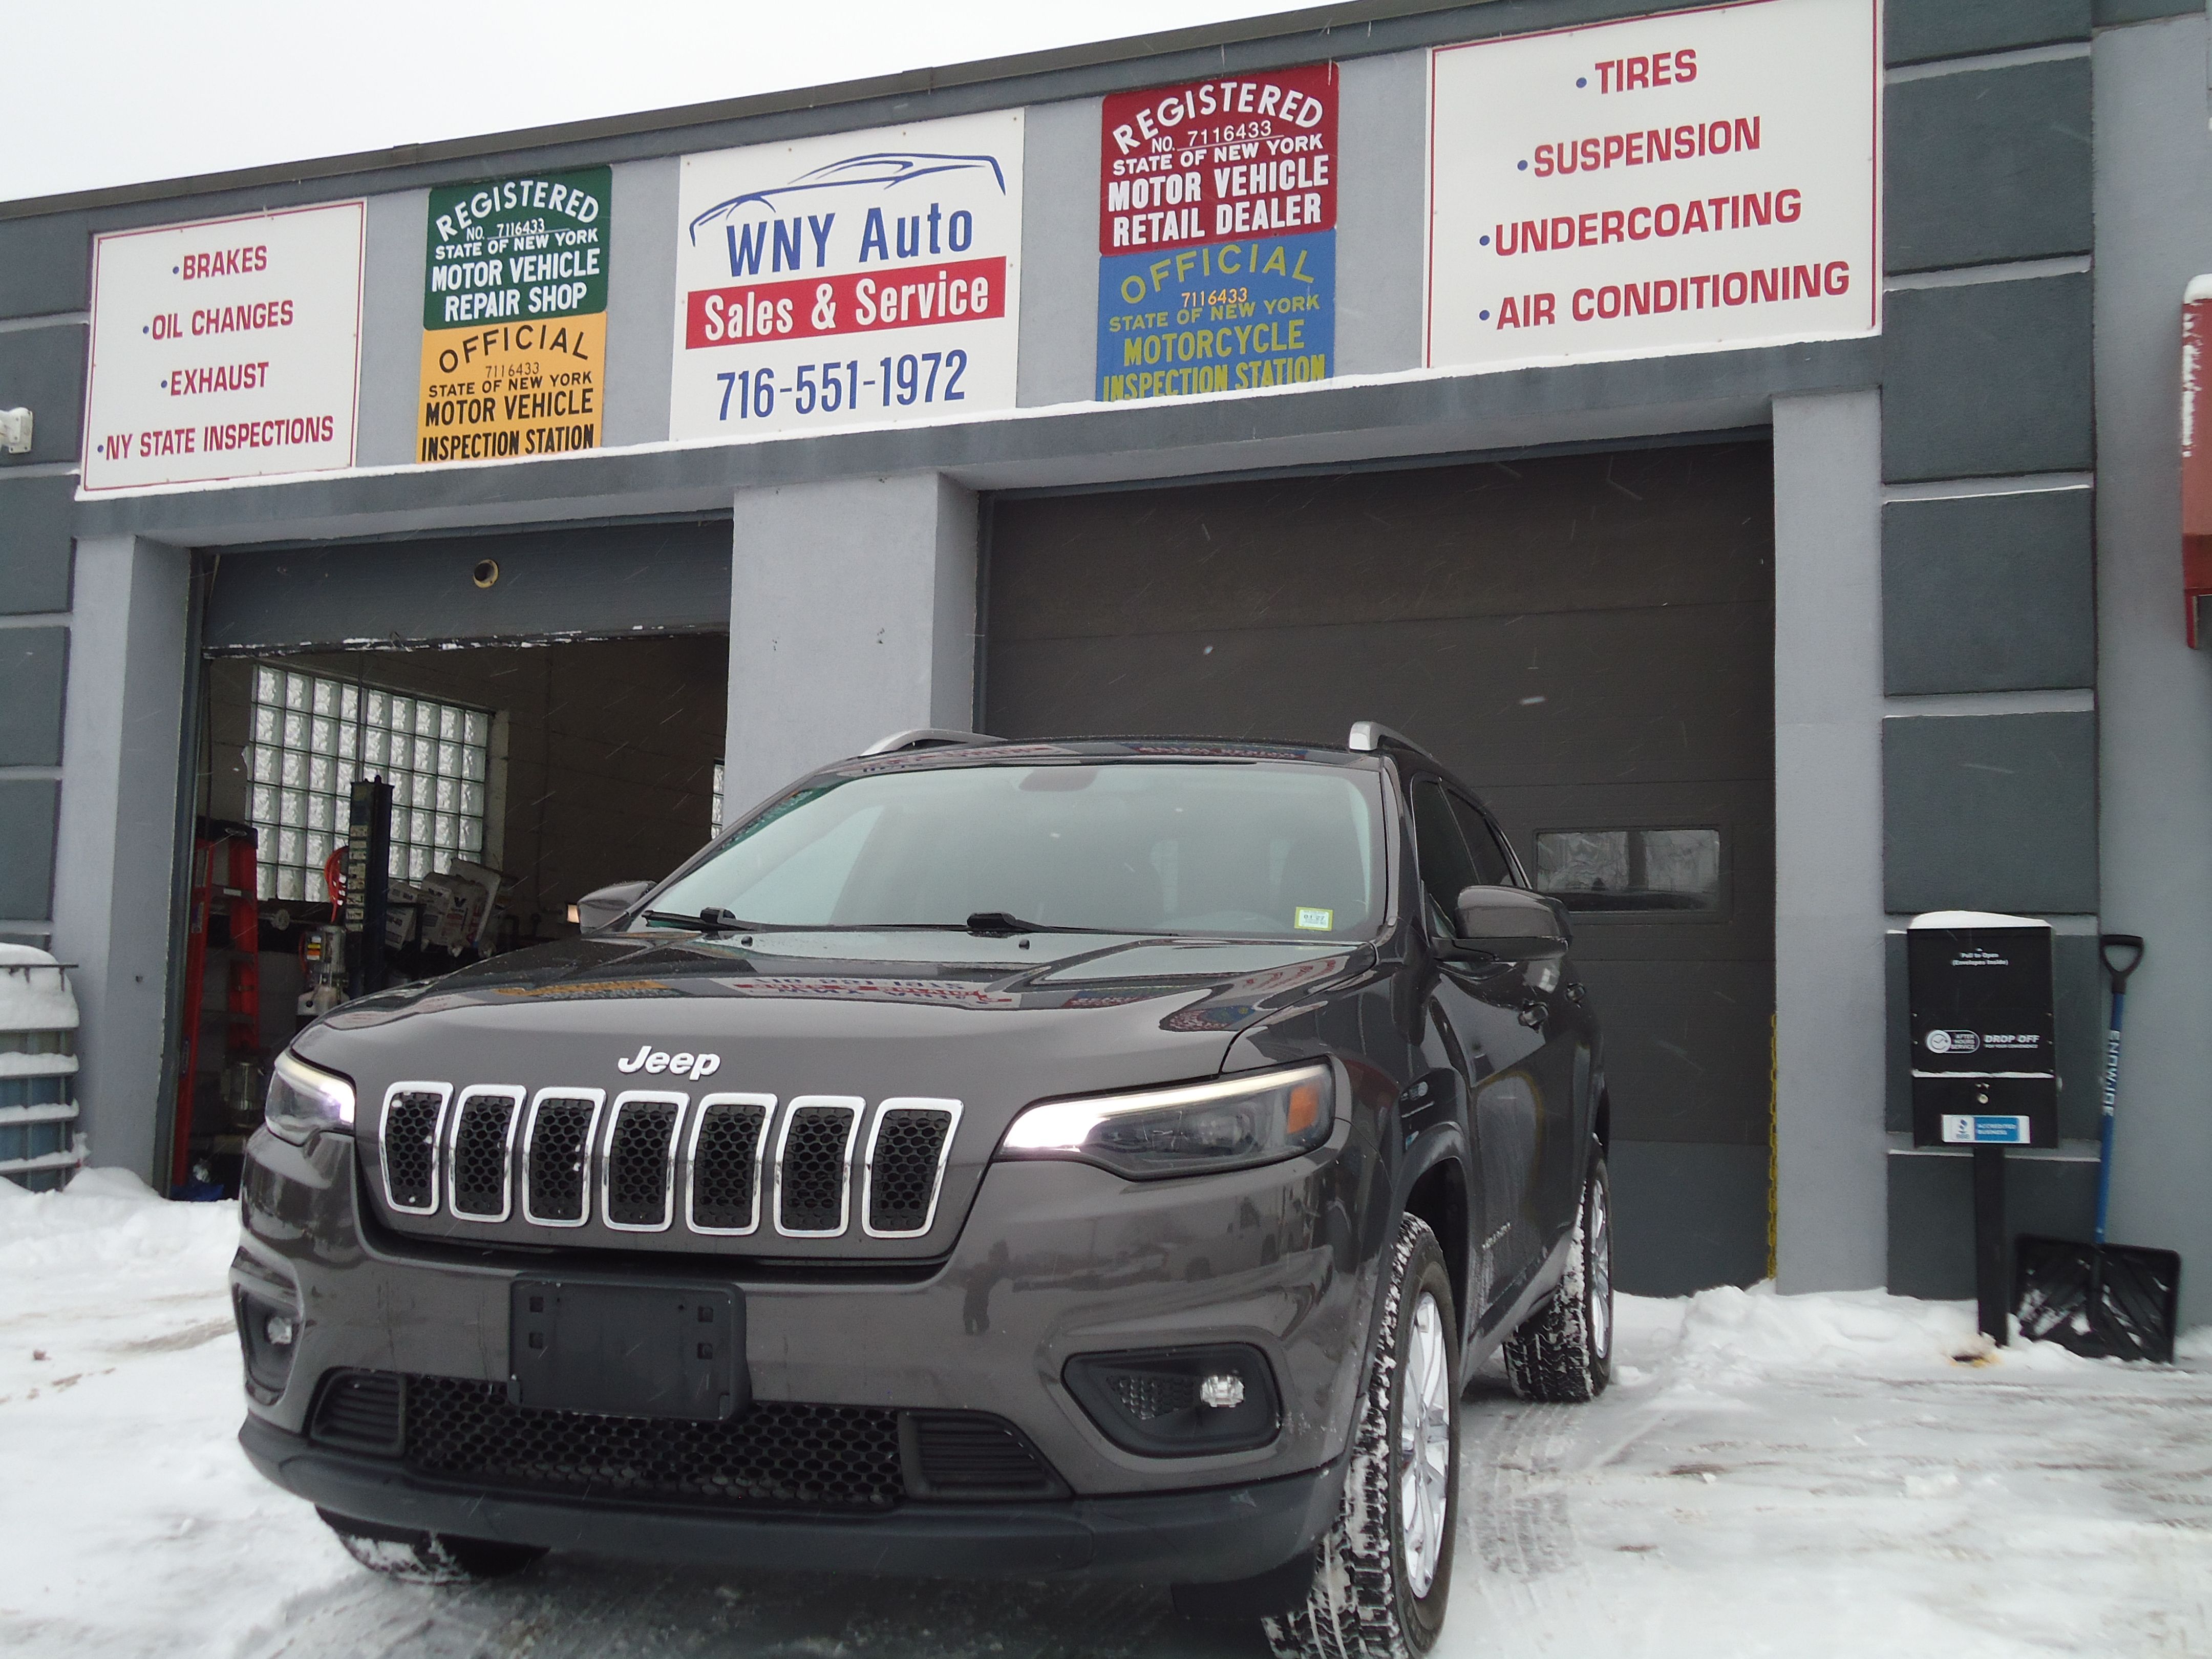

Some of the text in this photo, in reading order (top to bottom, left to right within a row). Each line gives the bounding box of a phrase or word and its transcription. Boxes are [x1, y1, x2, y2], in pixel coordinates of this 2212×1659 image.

[1595, 49, 1697, 94] TIRES
[1113, 81, 1323, 155] REGISTERED
[1152, 120, 1271, 153] NO. 7116433
[1113, 133, 1324, 176] STATE OF NEW YORK
[1535, 116, 1761, 178] SUSPENSION
[1109, 155, 1329, 212] MOTOR VEHICLE
[436, 180, 599, 242] REGISTERED
[466, 218, 545, 241] NO. 7116433
[1113, 193, 1321, 247] RETAIL DEALER
[1495, 188, 1802, 256] UNDERCOATING
[436, 228, 599, 260] STATE OF NEW YORK
[727, 203, 972, 277] WNY Auto
[183, 245, 267, 280] BRAKES
[432, 248, 600, 292] MOTOR VEHICLE
[1121, 243, 1315, 304] OFFICIAL
[445, 282, 587, 322] REPAIR SHOP
[705, 270, 988, 341] Sales & Service
[1109, 294, 1320, 333] STATE OF NEW YORK
[1182, 287, 1247, 308] 7116433
[1497, 261, 1850, 330] AIR CONDITIONING
[152, 300, 293, 340] OIL CHANGES
[439, 325, 588, 373] OFFICIAL
[1124, 319, 1305, 366] MOTORCYCLE
[171, 362, 269, 396] EXHAUST
[429, 371, 592, 397] STATE OF NEW YORK
[485, 362, 540, 378] 7116433
[717, 349, 968, 421] 716-551-1972
[1103, 353, 1325, 401] INSPECTION STATION
[426, 388, 593, 427] MOTOR VEHICLE
[106, 415, 333, 460] NY STATE INSPECTIONS
[421, 424, 594, 461] INSPECTION STATION
[1984, 1034, 2040, 1044] DROP OFF
[618, 1046, 721, 1081] Jeep
